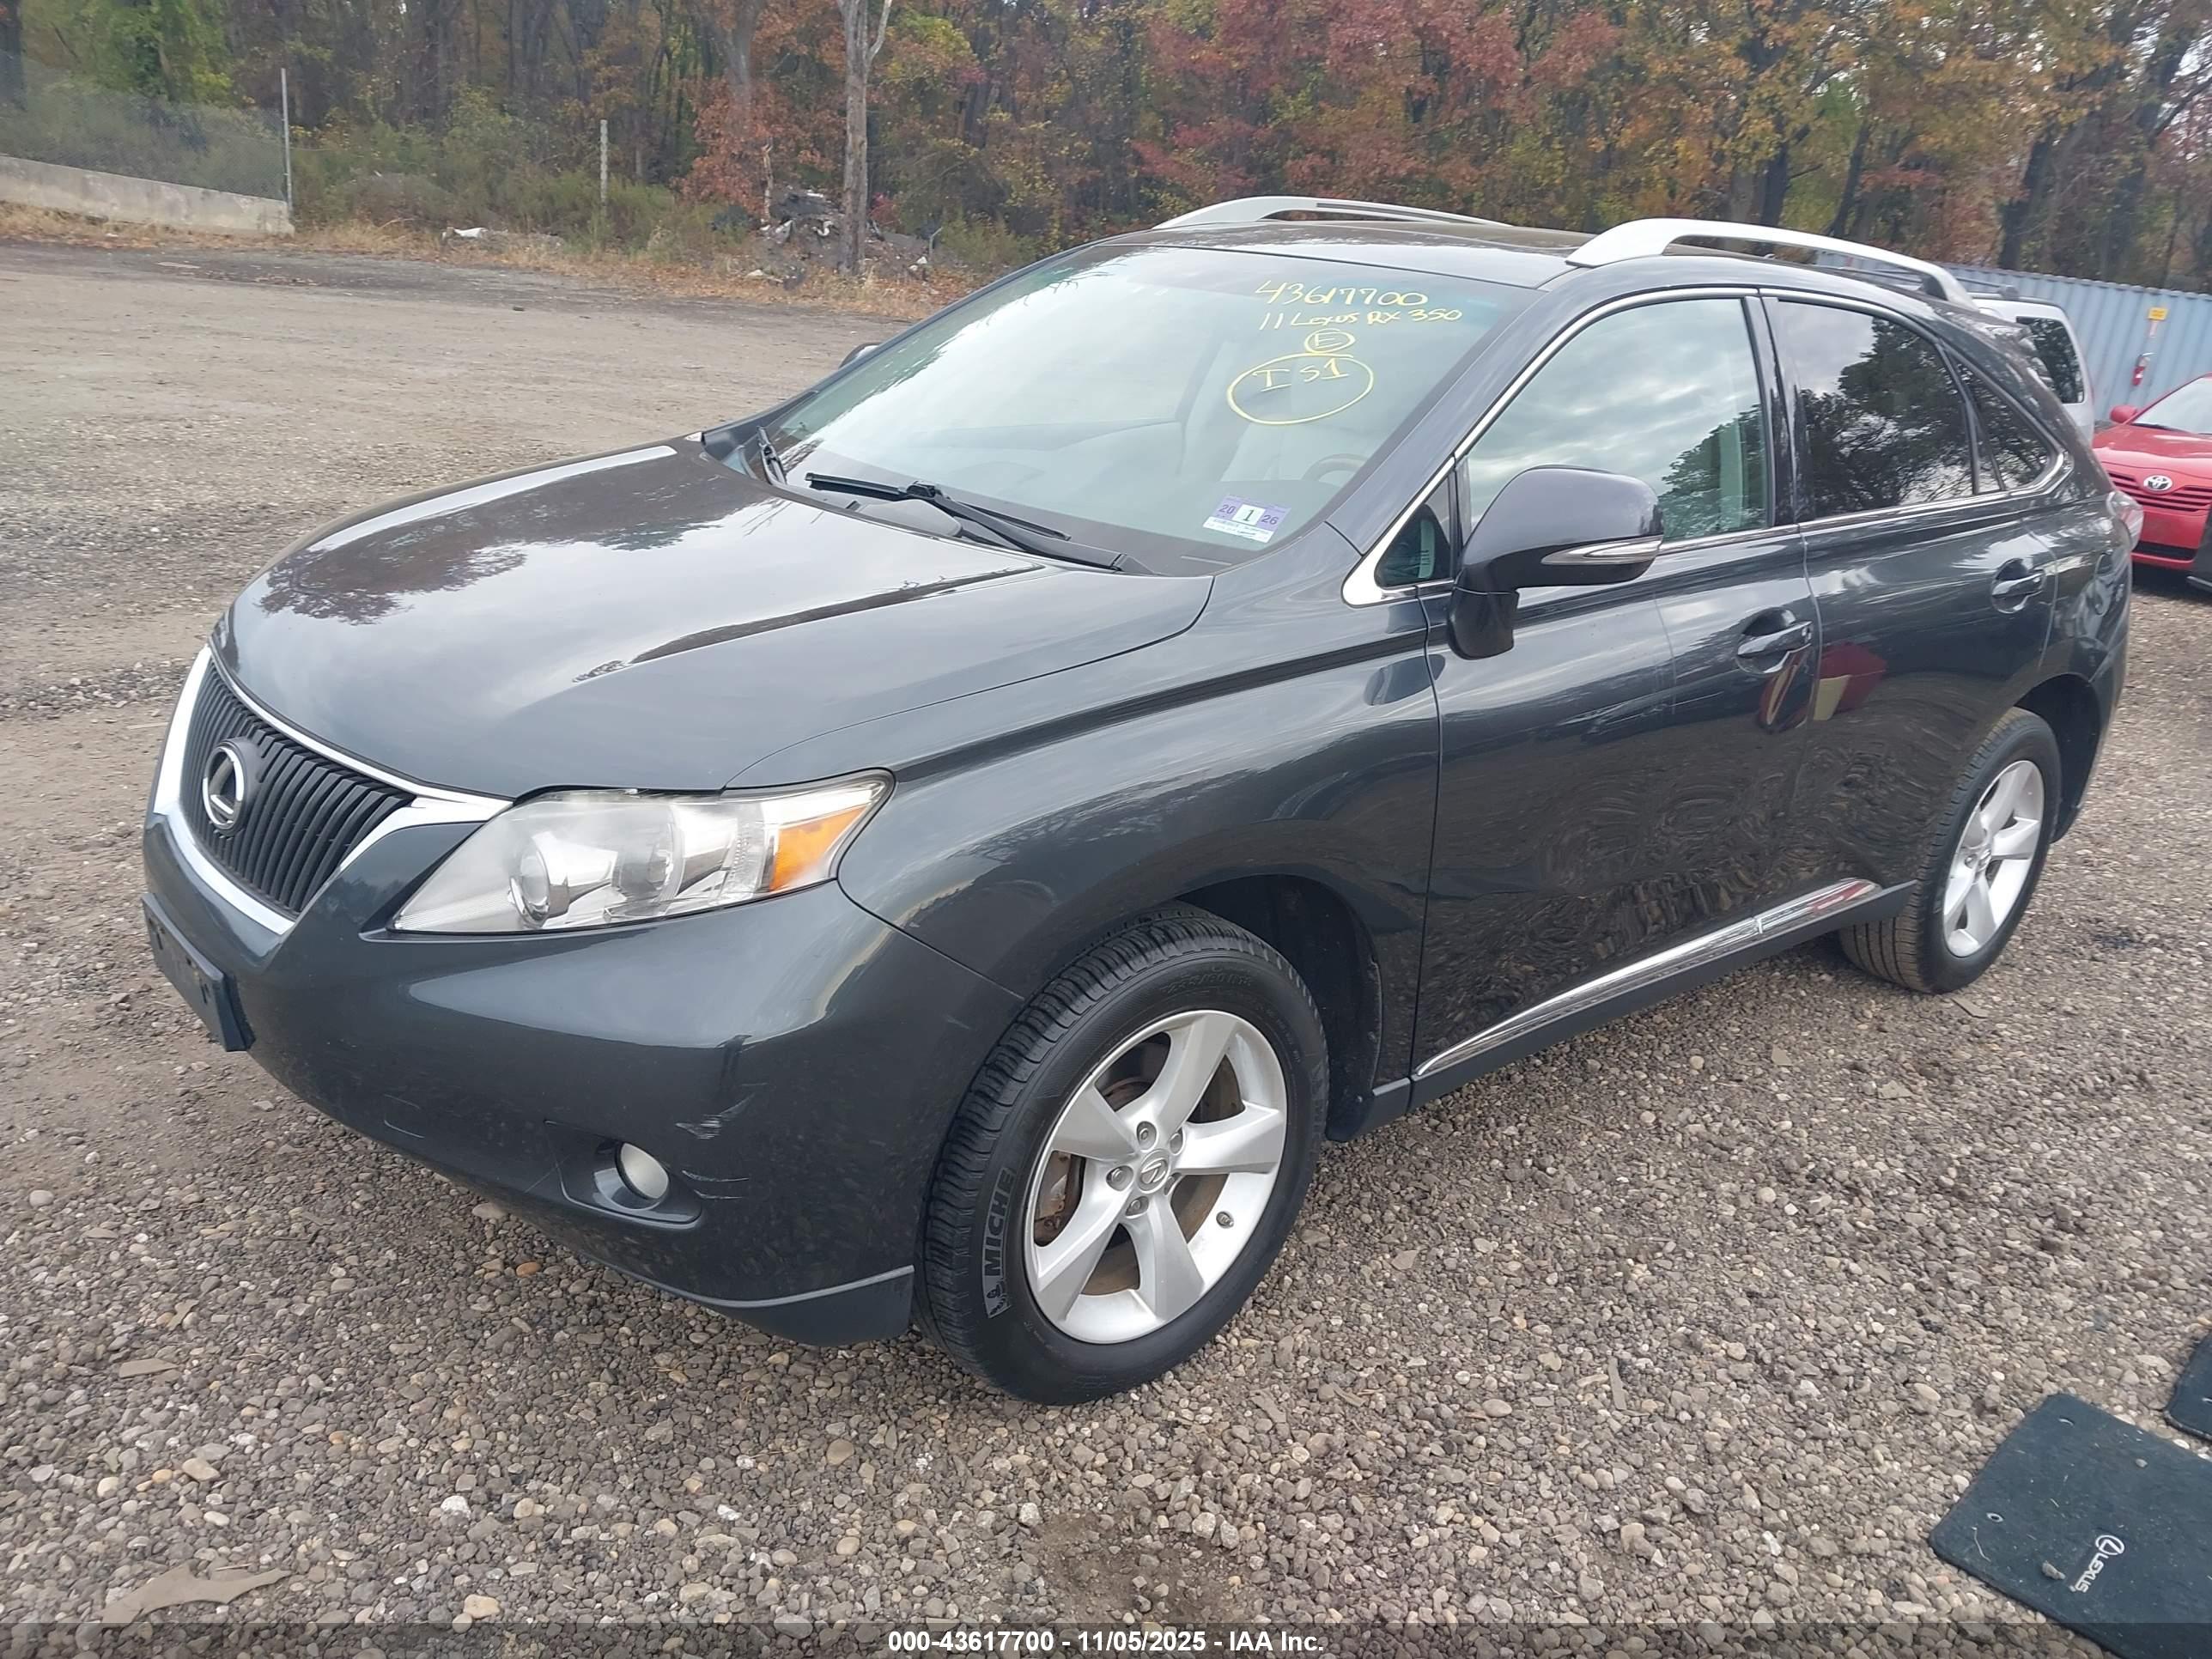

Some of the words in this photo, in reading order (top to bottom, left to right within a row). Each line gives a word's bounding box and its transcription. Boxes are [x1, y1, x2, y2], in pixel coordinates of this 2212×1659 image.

[1255, 279, 1429, 306] 43617700
[1367, 310, 1401, 325] RX
[1408, 307, 1463, 322] 350
[1218, 504, 1237, 514] 20
[1243, 509, 1255, 522] 1
[1261, 514, 1279, 526] 26
[2074, 1552, 2109, 1593] LEXUS
